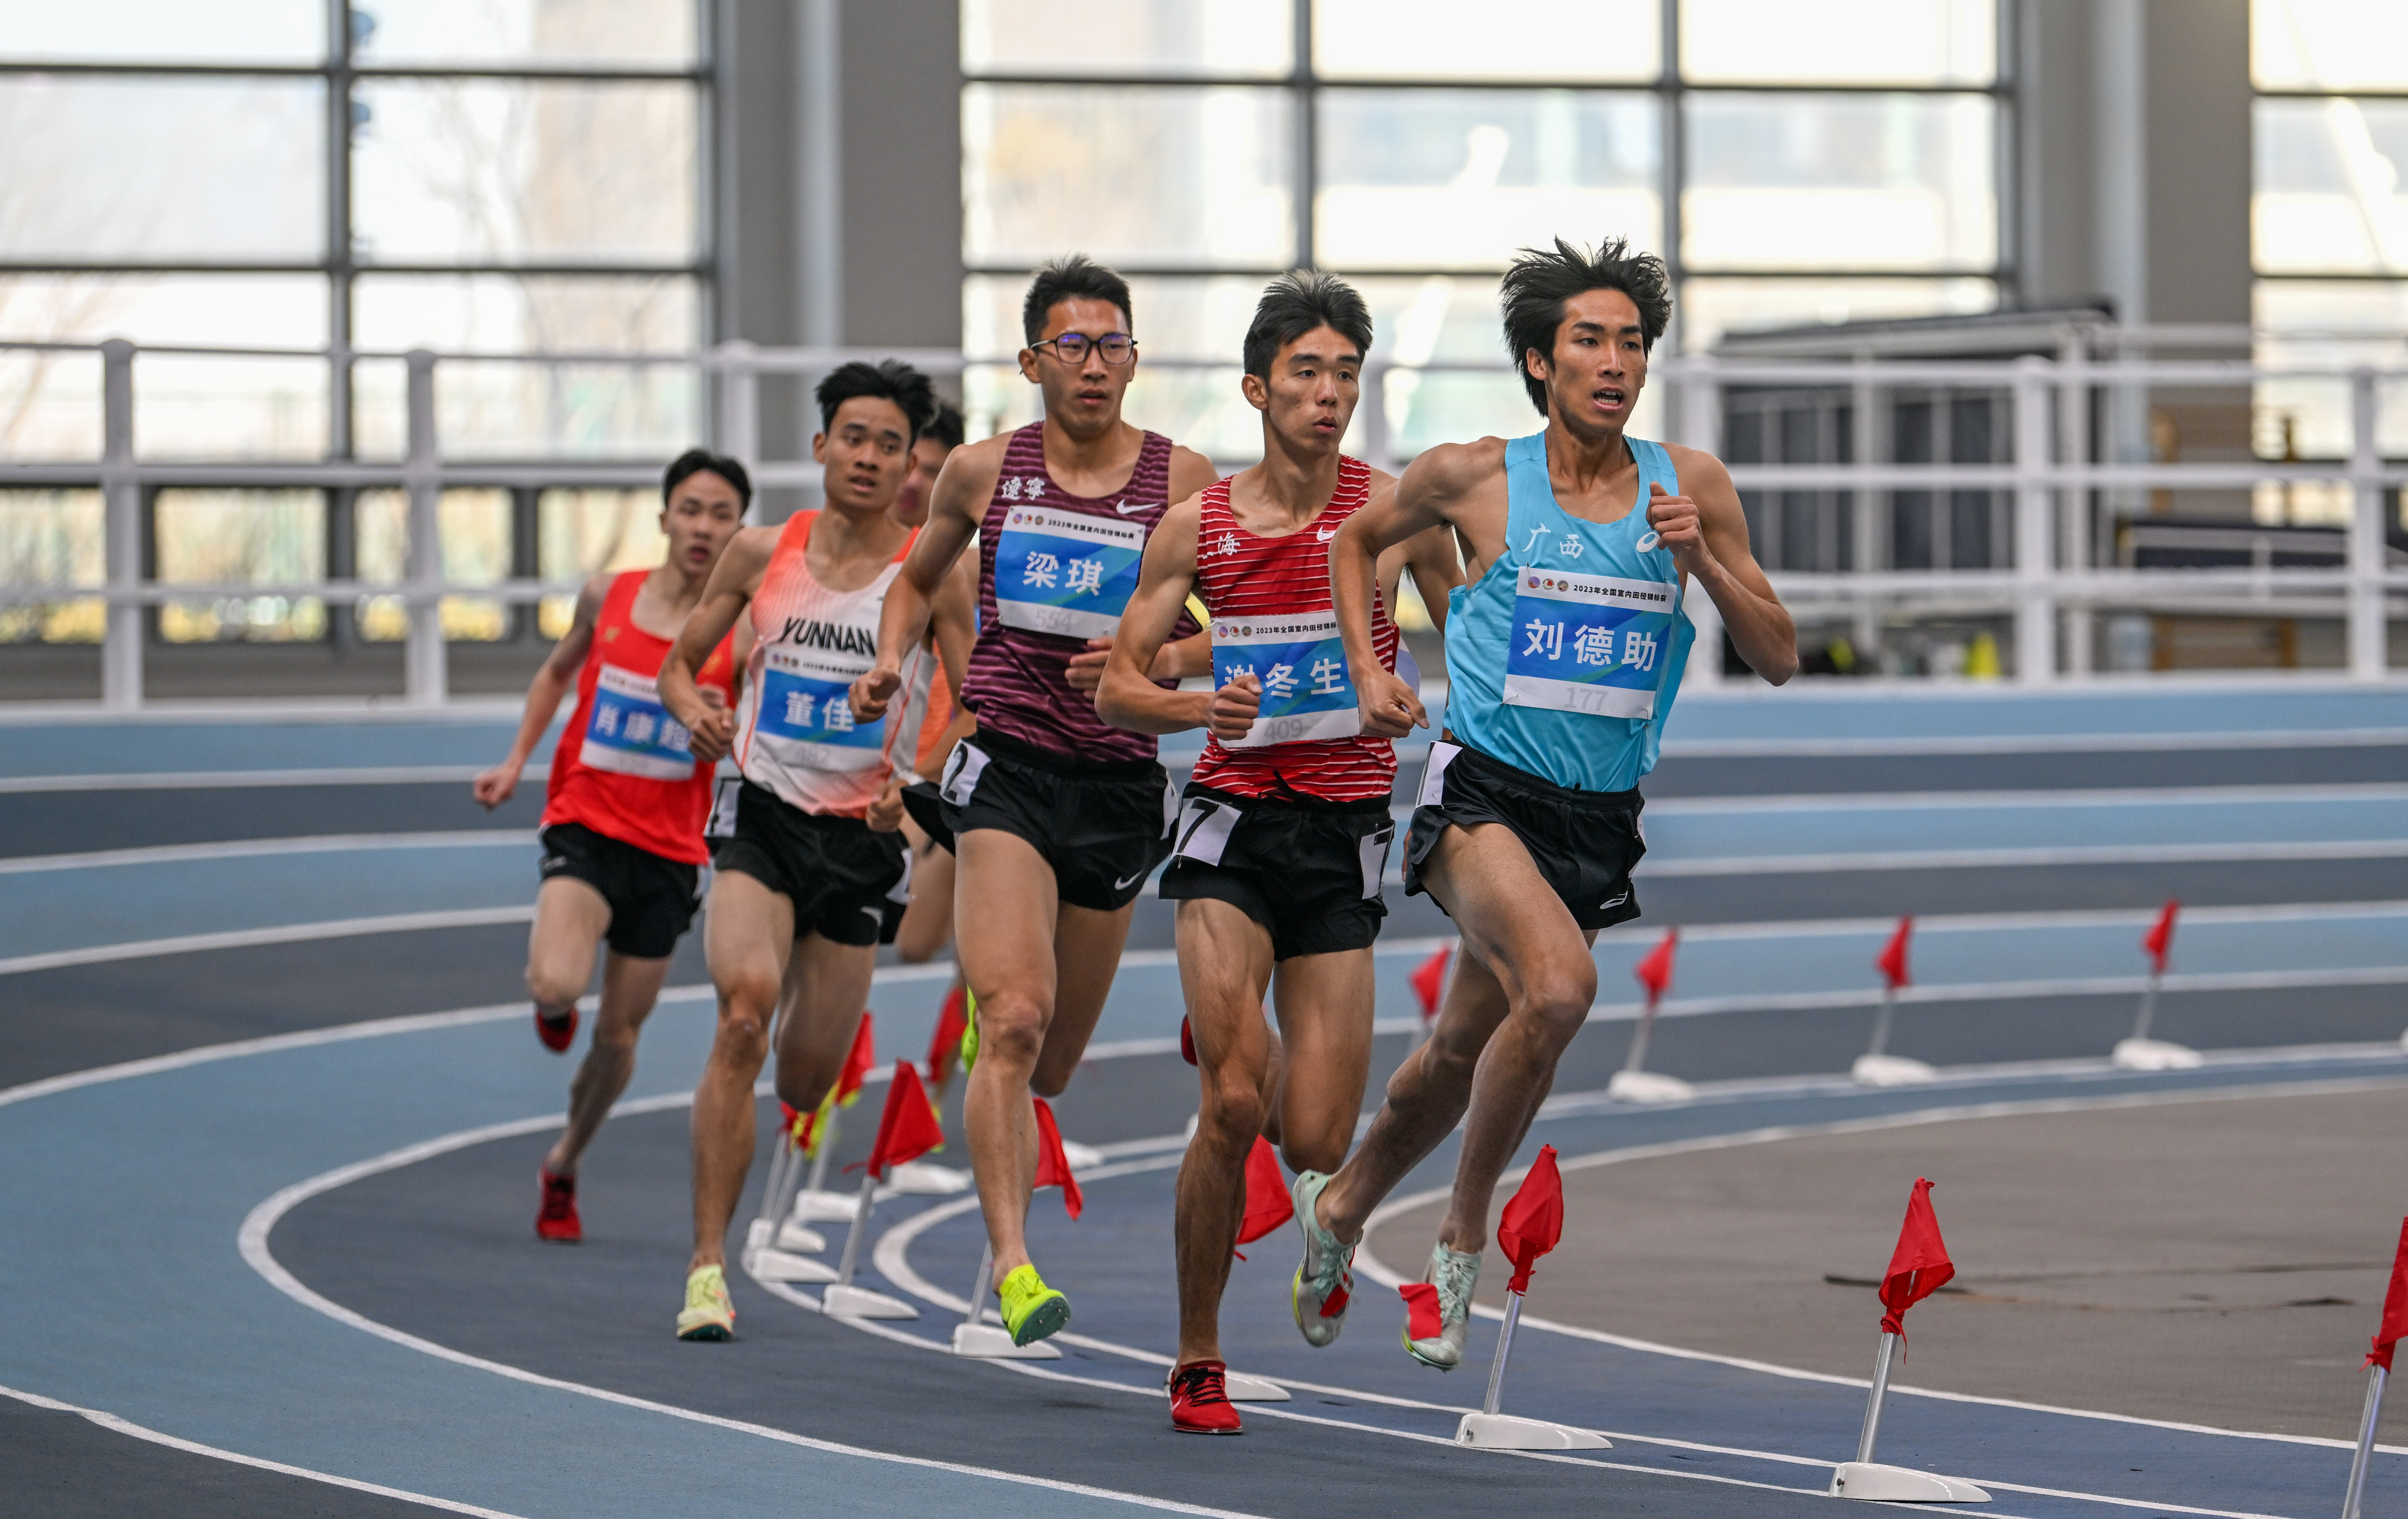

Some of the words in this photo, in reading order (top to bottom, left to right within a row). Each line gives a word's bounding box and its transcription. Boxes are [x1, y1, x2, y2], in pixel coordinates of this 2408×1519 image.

[1522, 522, 1584, 559] 广西
[1022, 551, 1104, 596] 梁琪
[1573, 585, 1667, 602] 2023年全国室内田径锦标赛
[777, 616, 876, 658] YUNNAN
[1522, 618, 1657, 671] 刘德助
[1564, 686, 1608, 712] 177
[1263, 718, 1303, 741] 409
[943, 743, 968, 802] 2
[1177, 799, 1220, 854] 7
